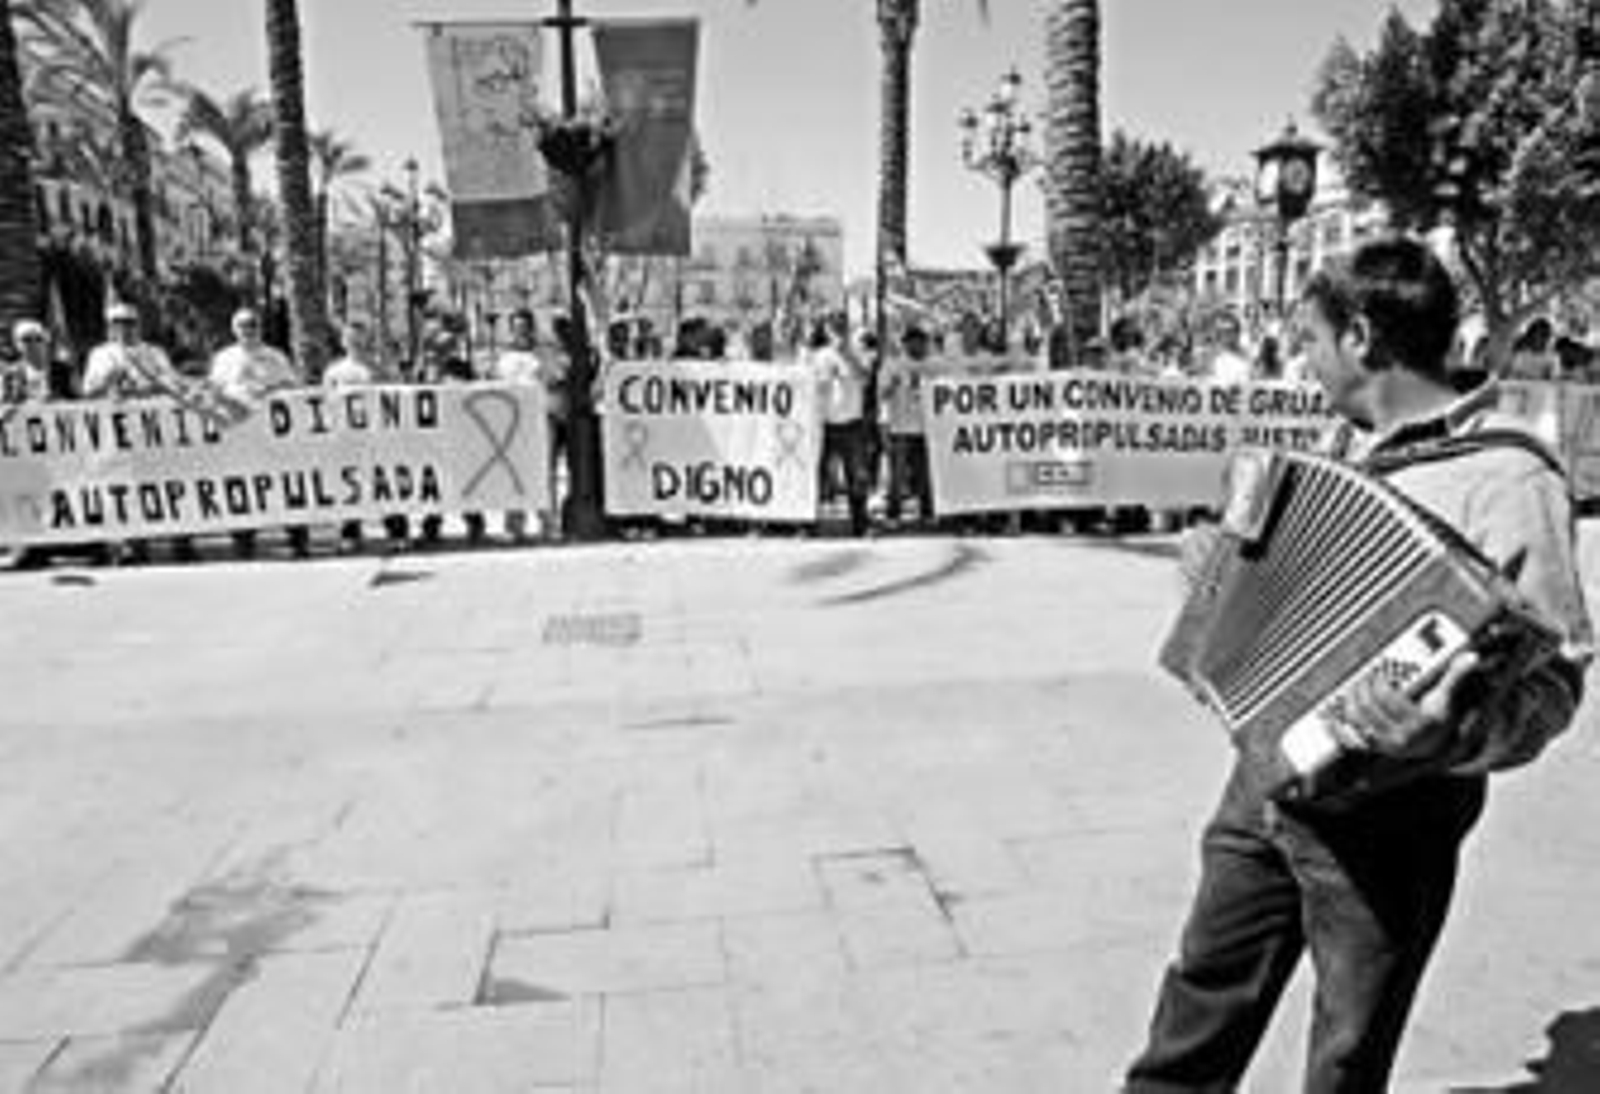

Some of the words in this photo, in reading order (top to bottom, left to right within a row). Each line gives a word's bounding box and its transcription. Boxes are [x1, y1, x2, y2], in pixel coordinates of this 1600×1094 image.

[270, 391, 439, 437] DIGNO
[618, 374, 793, 418] CONVENIO
[933, 384, 998, 415] POR
[1010, 382, 1054, 411] UN
[1063, 379, 1202, 414] CONVENIO
[1210, 386, 1241, 415] DE
[952, 421, 1227, 454] AUTOPROPULSADAS
[50, 465, 441, 529] AUTOPROPULSADA
[652, 461, 773, 505] DIGNO
